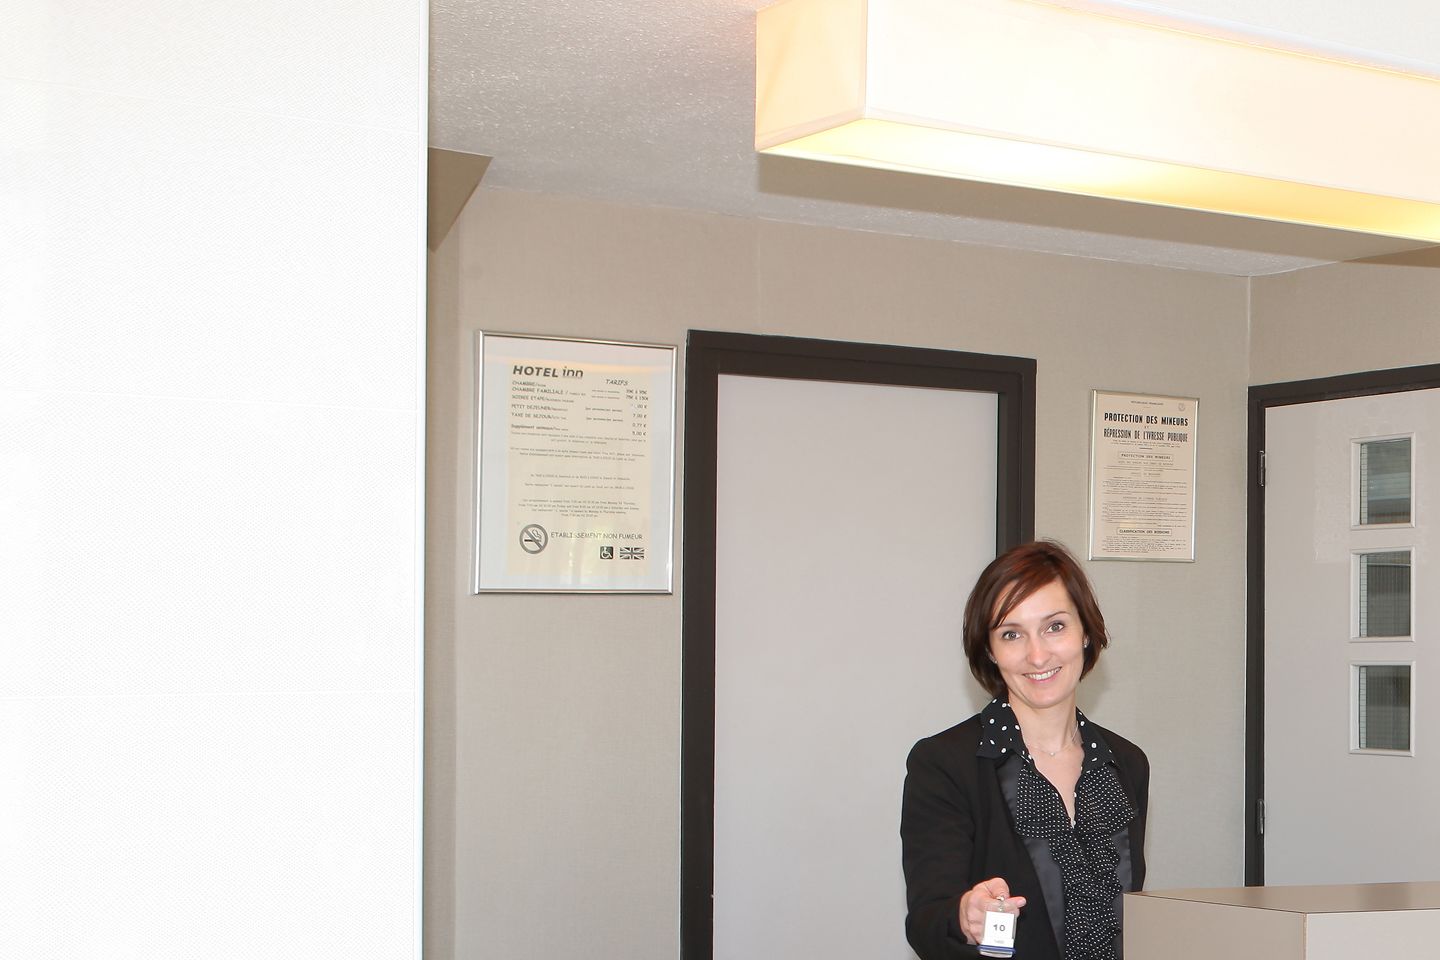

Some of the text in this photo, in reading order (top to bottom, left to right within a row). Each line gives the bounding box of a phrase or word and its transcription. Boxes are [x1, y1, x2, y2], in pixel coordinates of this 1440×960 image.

[512, 365, 584, 379] HOTEL inn
[1104, 412, 1188, 426] PROTECTION DES MINEURS
[1104, 427, 1188, 442] RÉPRESSION DE L'IVRESSE PUBLIQUE
